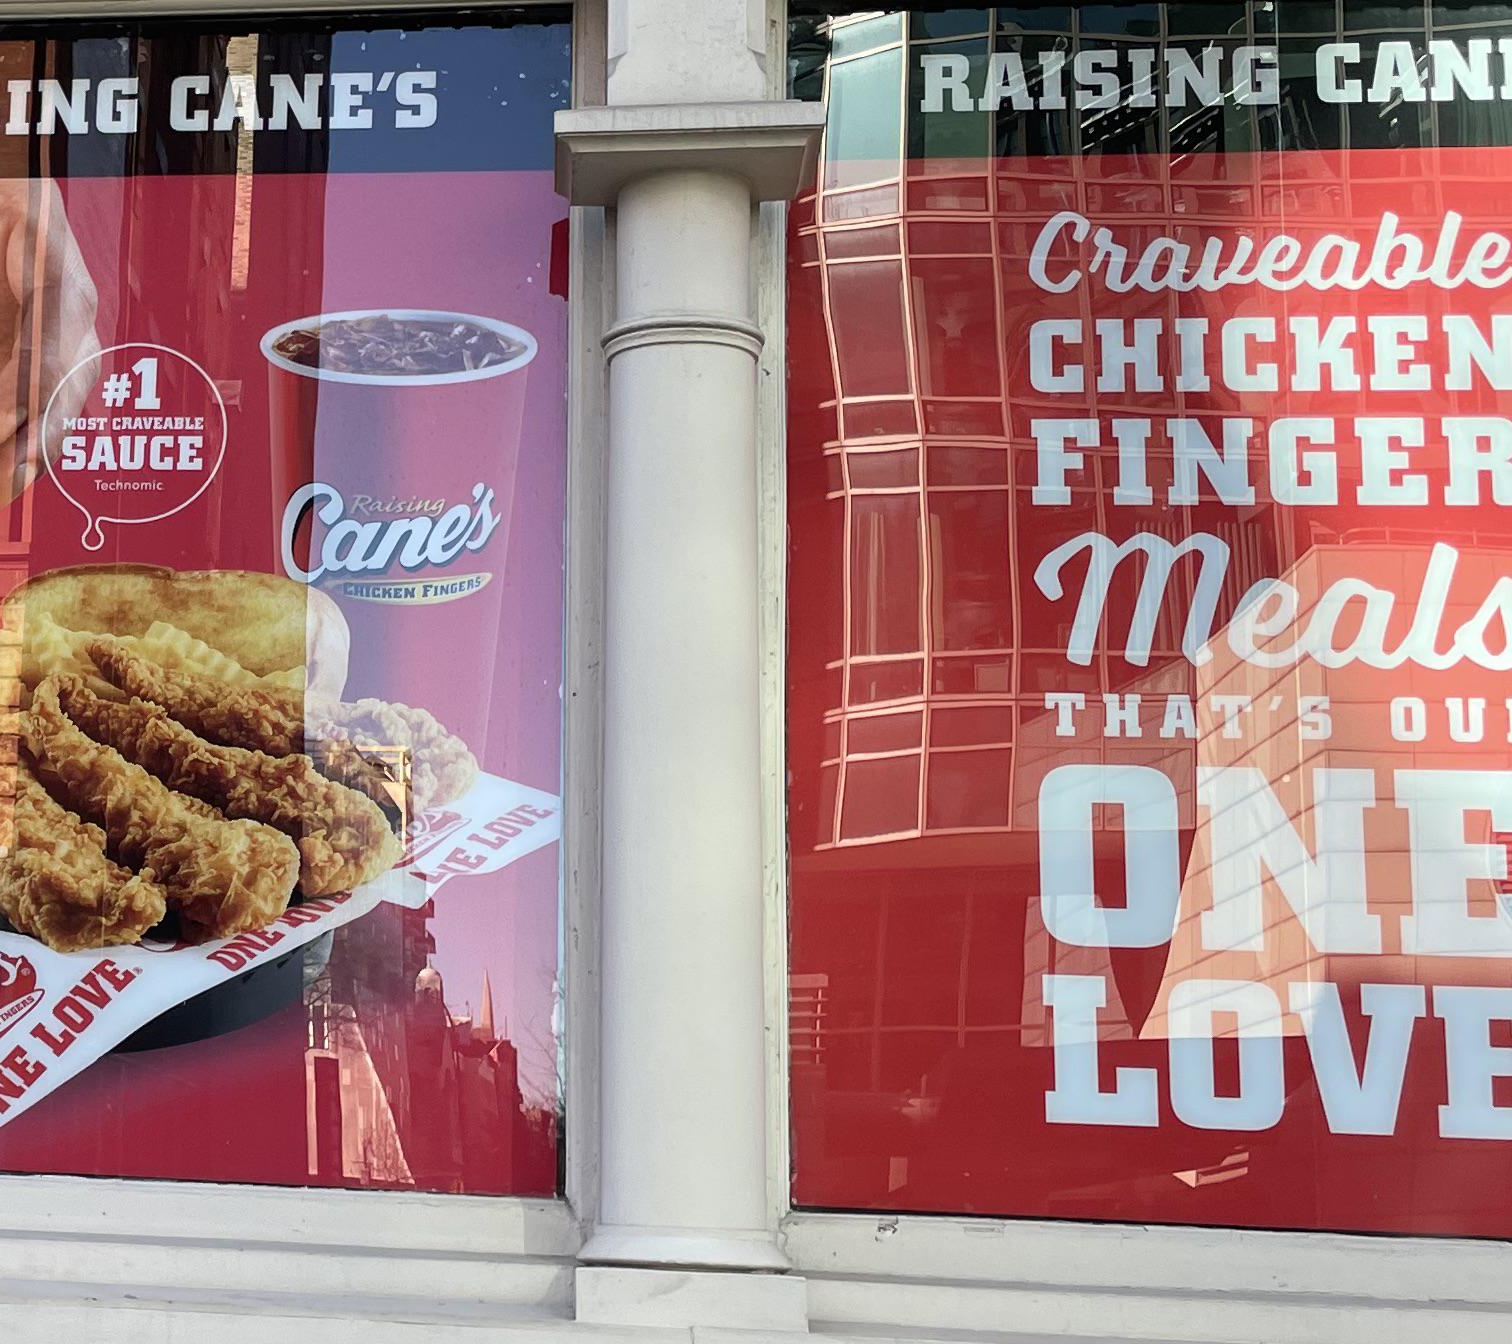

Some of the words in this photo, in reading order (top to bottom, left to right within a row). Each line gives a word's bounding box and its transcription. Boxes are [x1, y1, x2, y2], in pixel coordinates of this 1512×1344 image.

[170, 71, 439, 131] CANE'S
[919, 46, 1280, 113] RAISING
[1315, 38, 1512, 103] CAN
[1028, 210, 1512, 294] Craveable
[102, 357, 161, 410] #1
[1029, 315, 1512, 394] CHICKEN
[61, 435, 204, 471] SAUCE
[62, 417, 107, 431] MOST
[112, 416, 204, 431] CRAVEABLE
[94, 479, 164, 492] Technomic
[350, 494, 446, 517] Raising
[281, 482, 502, 585] Cane's
[343, 582, 415, 599] CHICKEN
[421, 575, 482, 598] FINGERS
[1033, 531, 1512, 671] Meals
[1044, 692, 1333, 741] THAT'S
[1389, 696, 1512, 744] OU
[466, 804, 554, 850] LOVE
[1038, 764, 1512, 958] ONE
[29, 958, 137, 1057] LOVE
[1041, 974, 1512, 1141] LOVE
